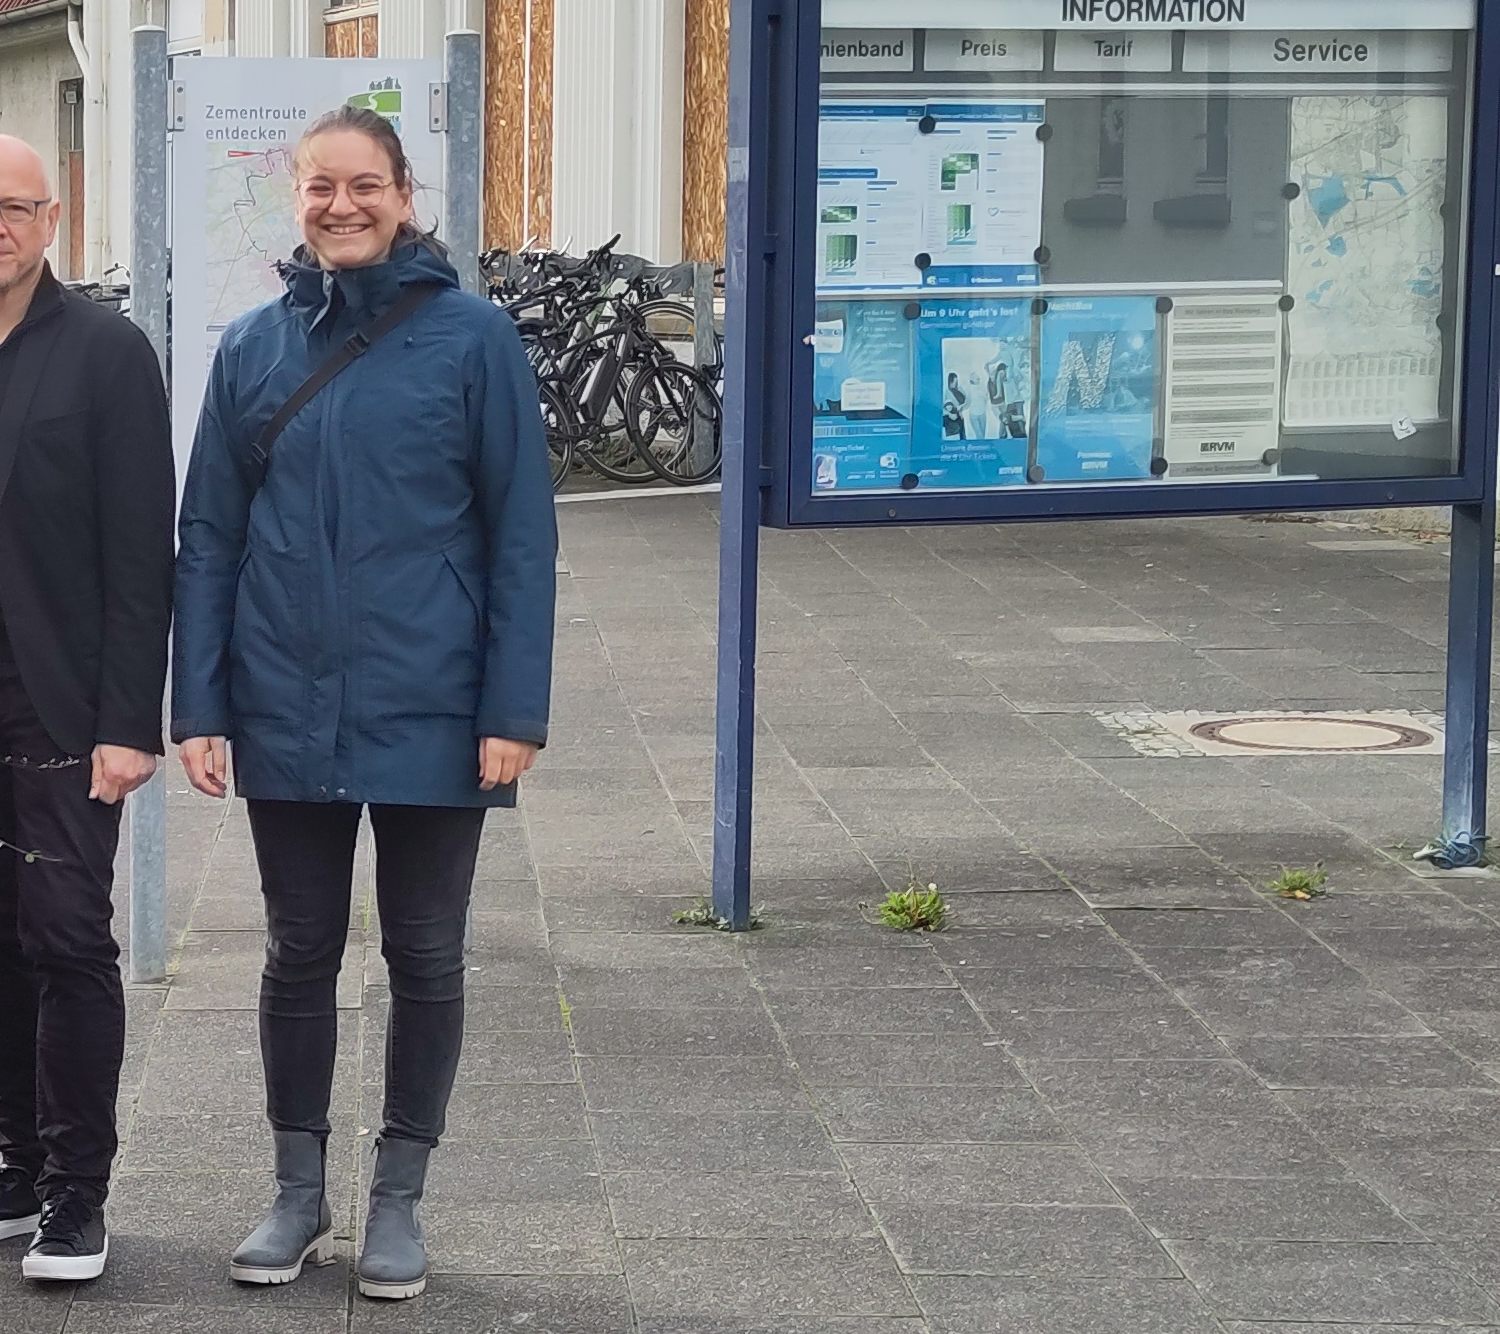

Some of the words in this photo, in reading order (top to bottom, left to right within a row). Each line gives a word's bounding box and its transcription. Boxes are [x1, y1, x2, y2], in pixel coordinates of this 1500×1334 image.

[821, 39, 904, 58] nienband
[960, 38, 1007, 57] Preis
[1094, 38, 1133, 58] Tarif
[1272, 37, 1368, 64] Service
[205, 105, 307, 121] Zementroute
[205, 125, 287, 141] entdecken
[920, 308, 937, 318] Um
[948, 307, 966, 317] Uhr
